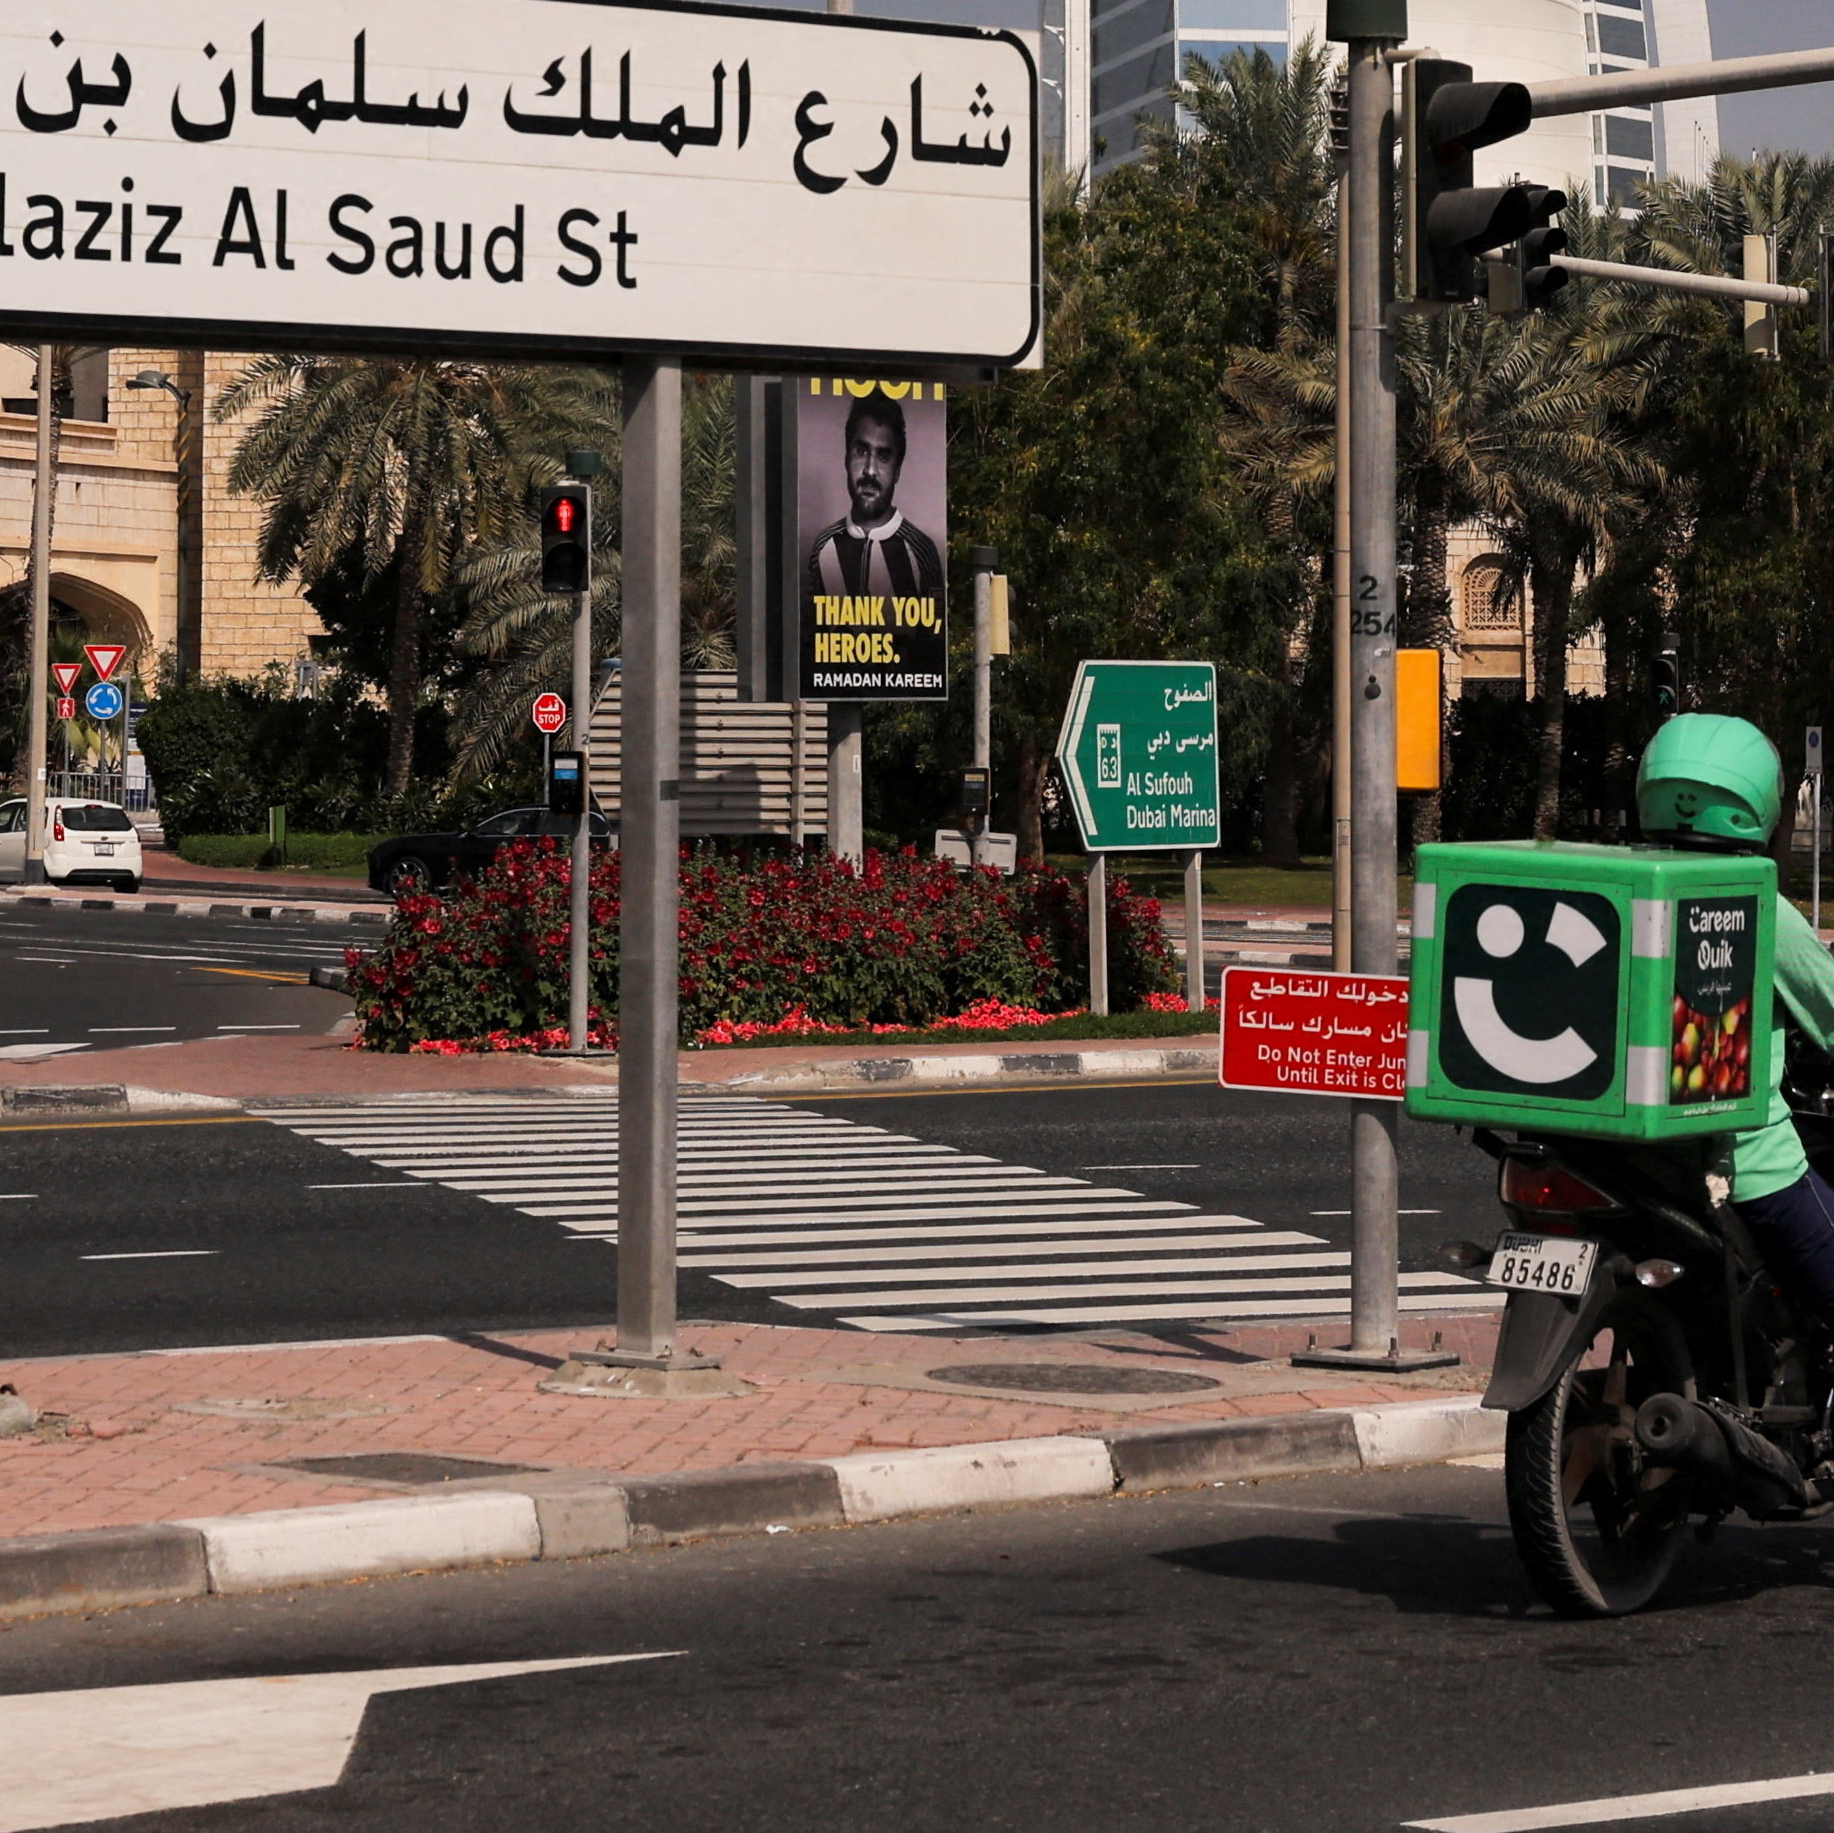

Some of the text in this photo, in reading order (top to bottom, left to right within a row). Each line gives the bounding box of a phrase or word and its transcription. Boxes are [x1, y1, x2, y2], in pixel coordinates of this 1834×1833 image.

[16, 31, 131, 136] بن
[172, 21, 468, 143] سلمان
[504, 47, 750, 157] الملك
[794, 74, 1010, 194] شارع
[213, 187, 294, 270] Al
[327, 194, 524, 283] Saud
[558, 209, 637, 288] St
[1359, 575, 1378, 600] 2
[813, 595, 942, 634] THANK YOU,
[815, 633, 900, 663] HEROES.
[813, 673, 942, 688] RAMADAN KAREEM
[539, 699, 560, 712] قف
[1164, 680, 1212, 710] الصفوح
[538, 714, 561, 724] STOP
[1101, 737, 1107, 749] D
[1147, 730, 1214, 760] مرسى دبي
[1102, 757, 1117, 779] 63
[1126, 771, 1193, 796] Al Sufouh
[1127, 802, 1215, 829] Dubai Marina
[1689, 906, 1745, 933] Careem
[1698, 939, 1733, 970] Quik
[1250, 977, 1329, 1000] التقاطع
[1301, 1016, 1372, 1039] مسارك
[1258, 1044, 1406, 1070] Do Not Enter Jun
[1277, 1066, 1318, 1084] Until
[1324, 1069, 1358, 1087] Exit
[1363, 1072, 1376, 1088] is
[1578, 1243, 1589, 1259] 2
[1501, 1257, 1576, 1291] 85486
